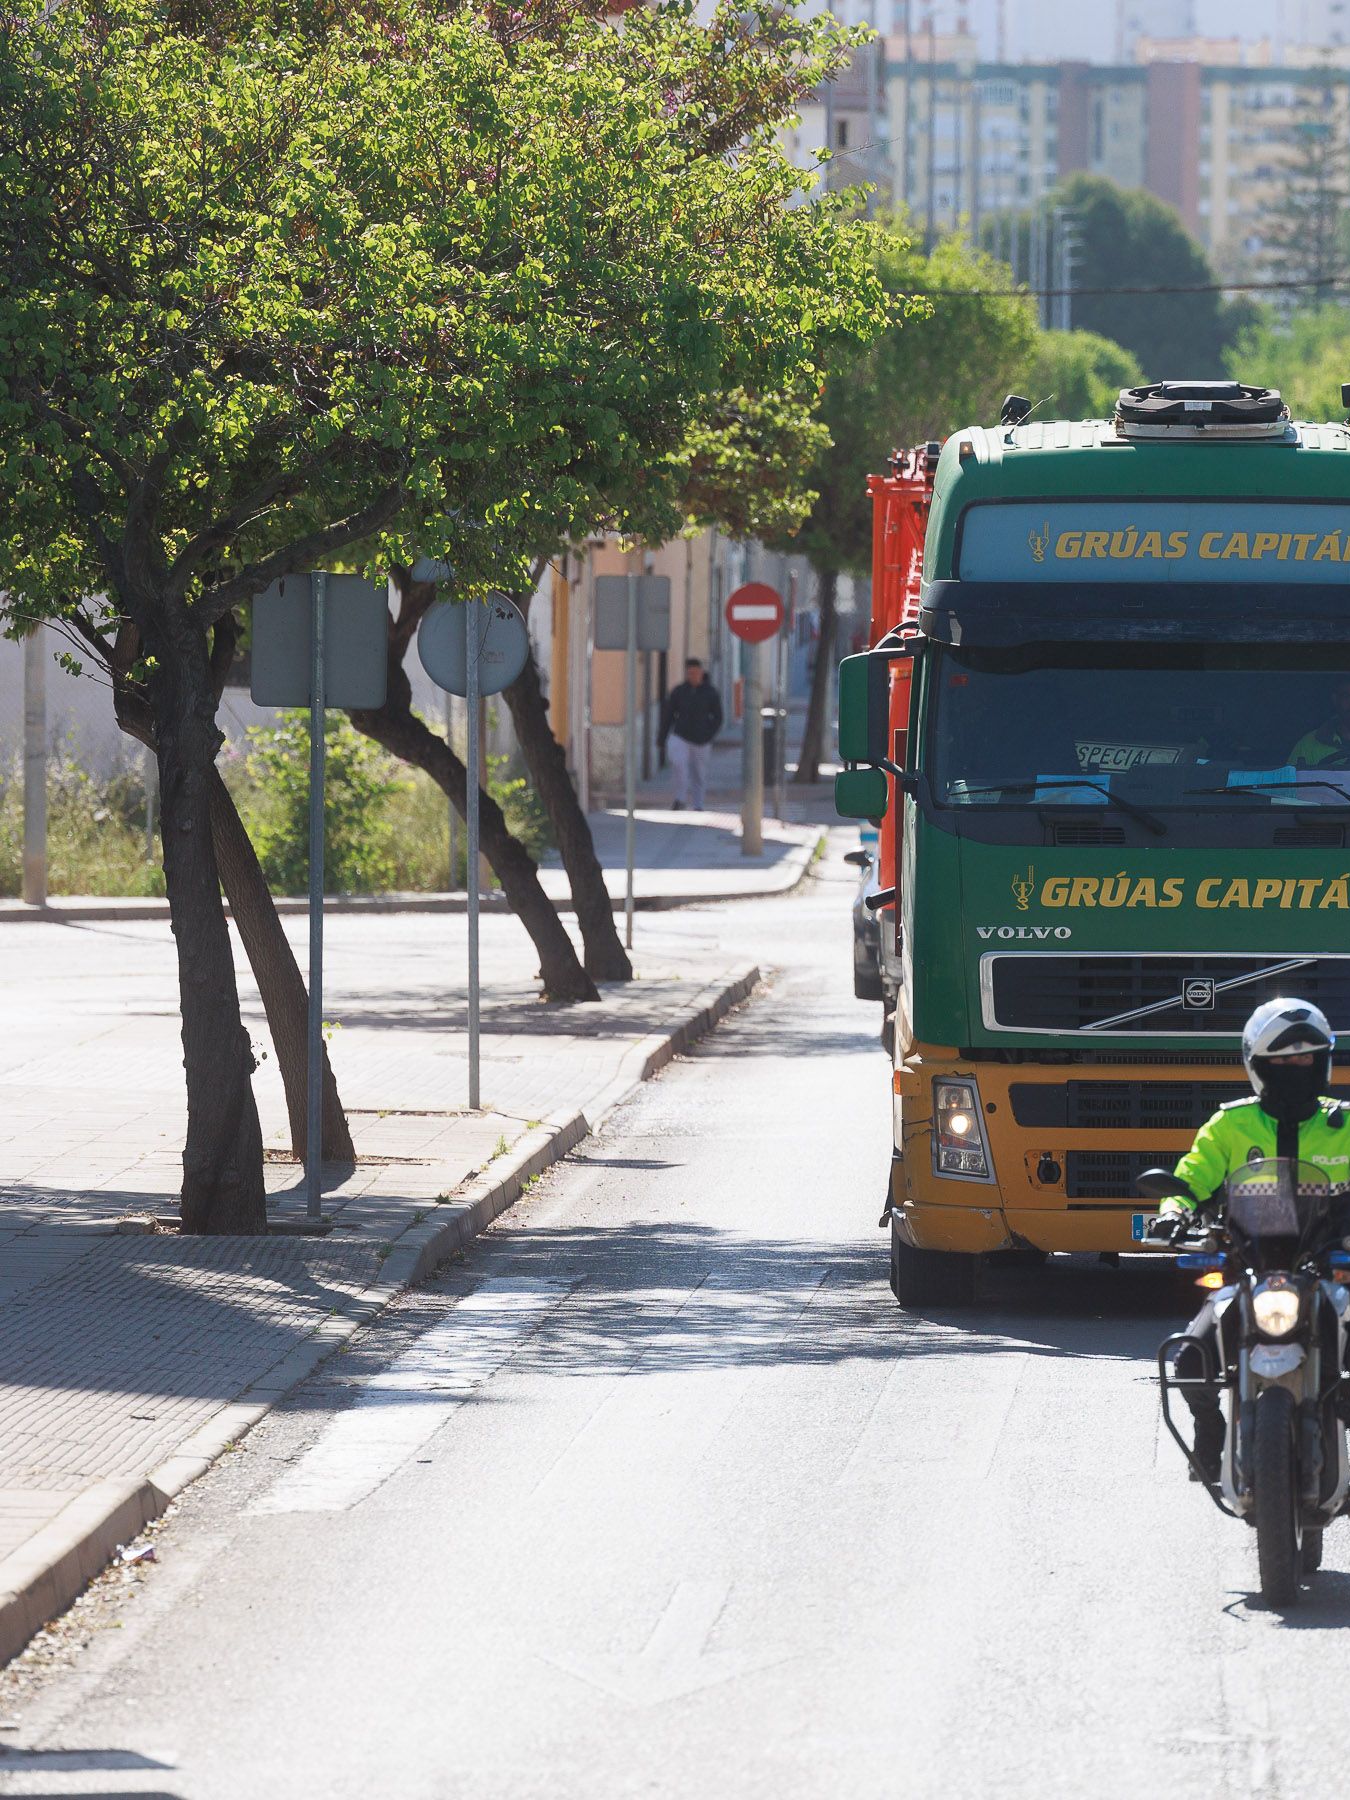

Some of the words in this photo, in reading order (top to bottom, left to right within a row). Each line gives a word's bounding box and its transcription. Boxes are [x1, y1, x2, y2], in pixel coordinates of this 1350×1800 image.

[1055, 528, 1188, 559] GRÚAS
[1040, 872, 1185, 908] GRÚAS
[976, 926, 1072, 939] VOLVO
